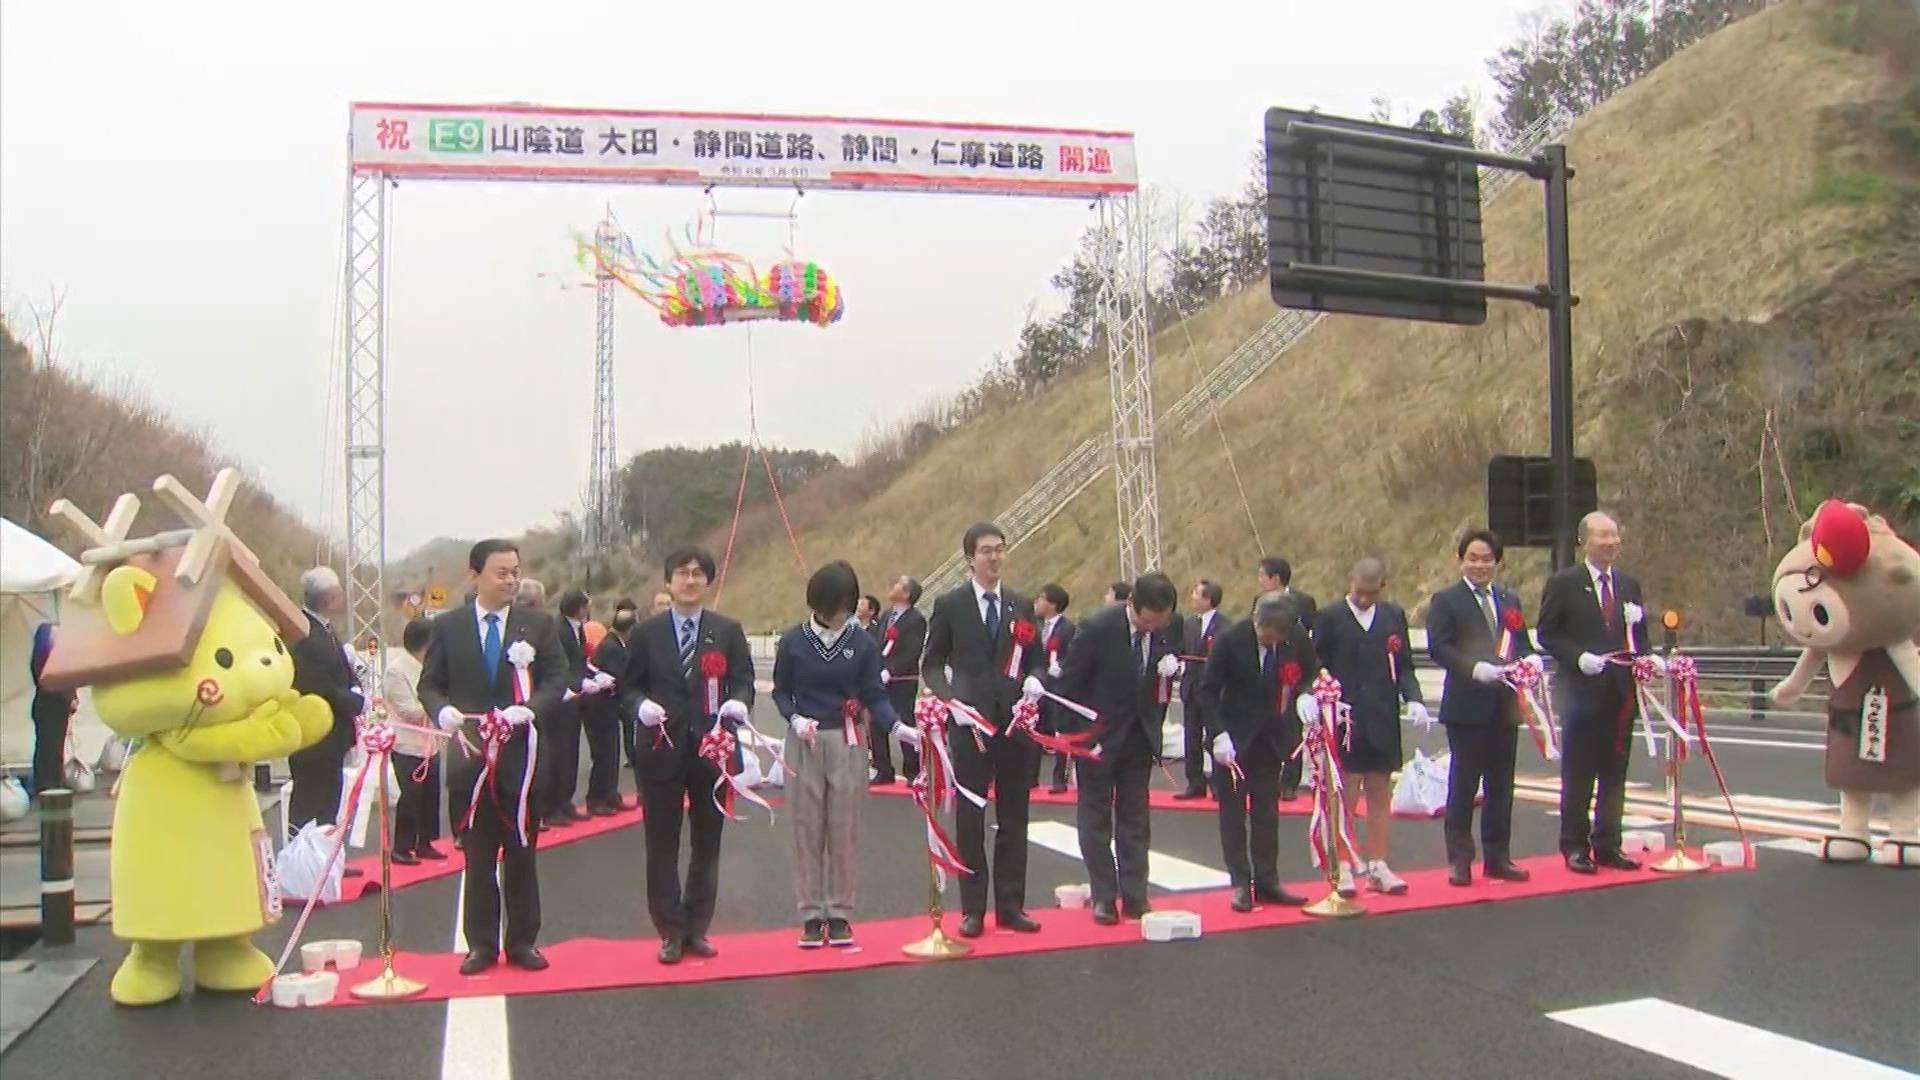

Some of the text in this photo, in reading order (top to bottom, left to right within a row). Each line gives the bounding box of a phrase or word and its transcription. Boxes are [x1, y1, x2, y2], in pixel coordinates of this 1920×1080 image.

[376, 118, 411, 151] 祝
[433, 120, 481, 152] E9
[490, 122, 585, 155] 山陰道
[1058, 144, 1113, 174] 開通
